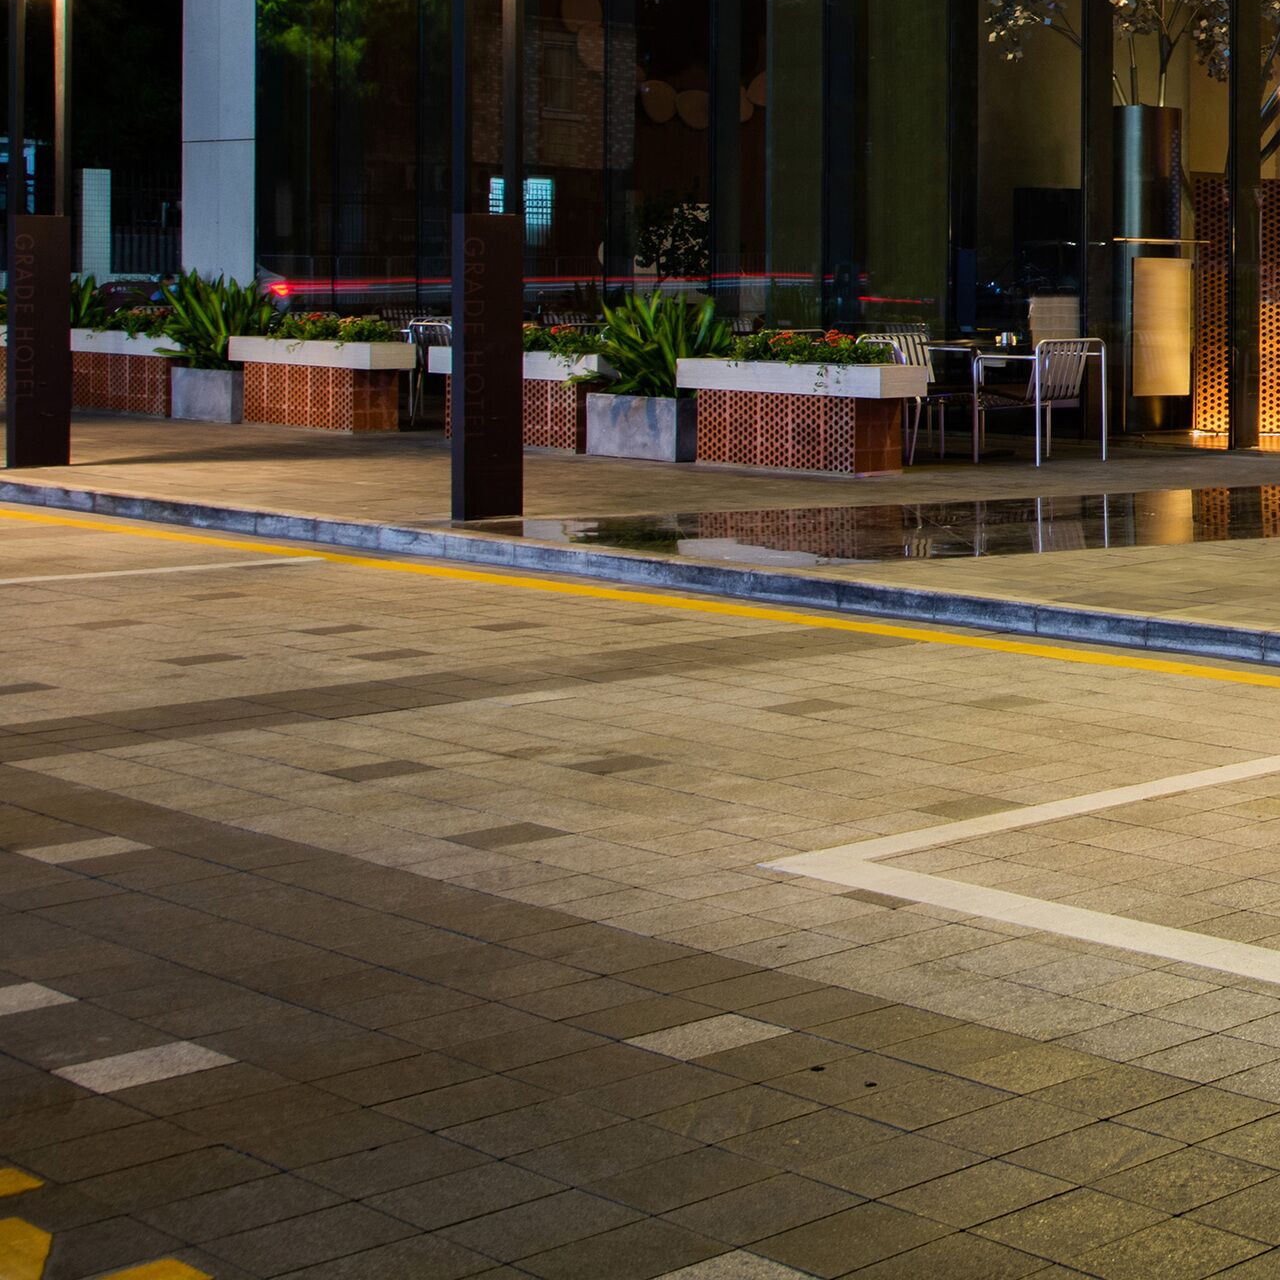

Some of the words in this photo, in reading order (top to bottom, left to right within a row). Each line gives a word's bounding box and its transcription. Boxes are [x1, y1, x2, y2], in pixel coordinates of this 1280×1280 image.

[15, 233, 35, 314] GRADE
[463, 236, 486, 336] GRADE
[15, 327, 34, 401] HOTEL
[463, 350, 486, 438] HOTEL
